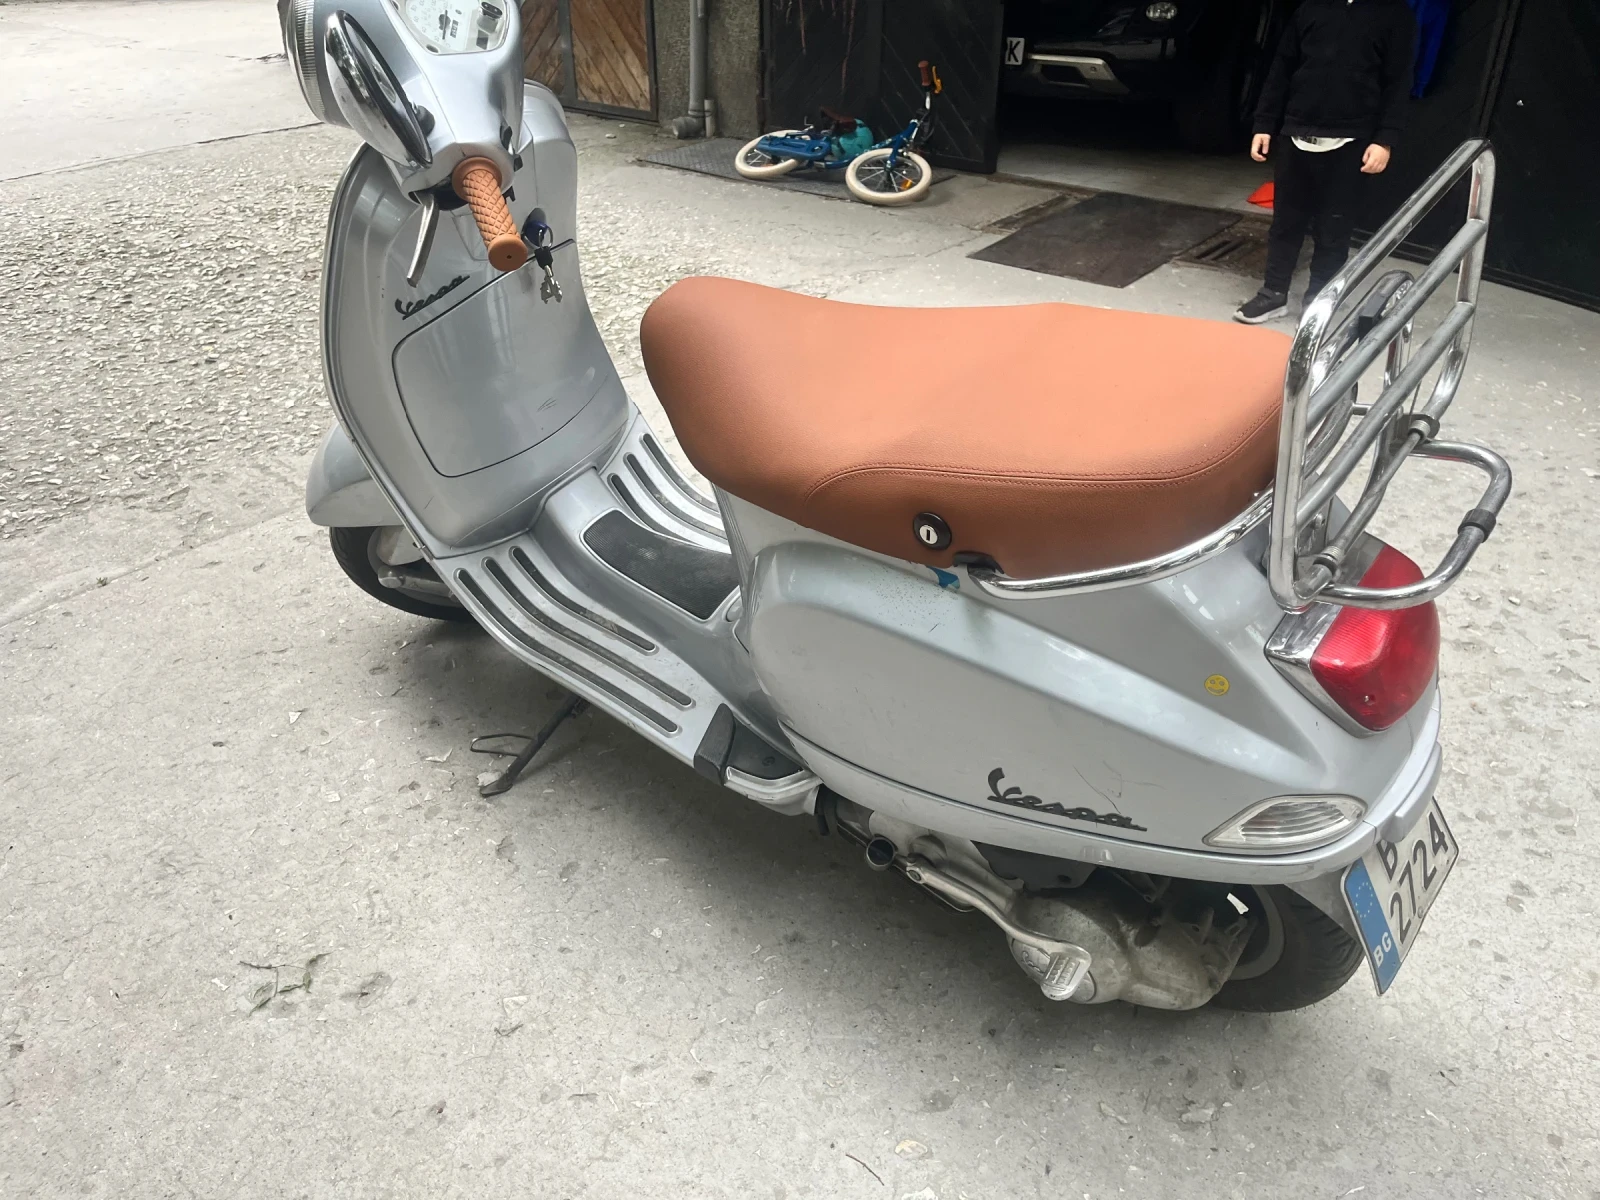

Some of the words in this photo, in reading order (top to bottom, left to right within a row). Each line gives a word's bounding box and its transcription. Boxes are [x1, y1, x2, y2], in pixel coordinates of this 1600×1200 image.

[1007, 40, 1021, 62] K
[395, 275, 470, 320] Vespa
[987, 767, 1148, 832] Vespa
[1390, 811, 1449, 944] 2724
[1373, 932, 1392, 967] BG
